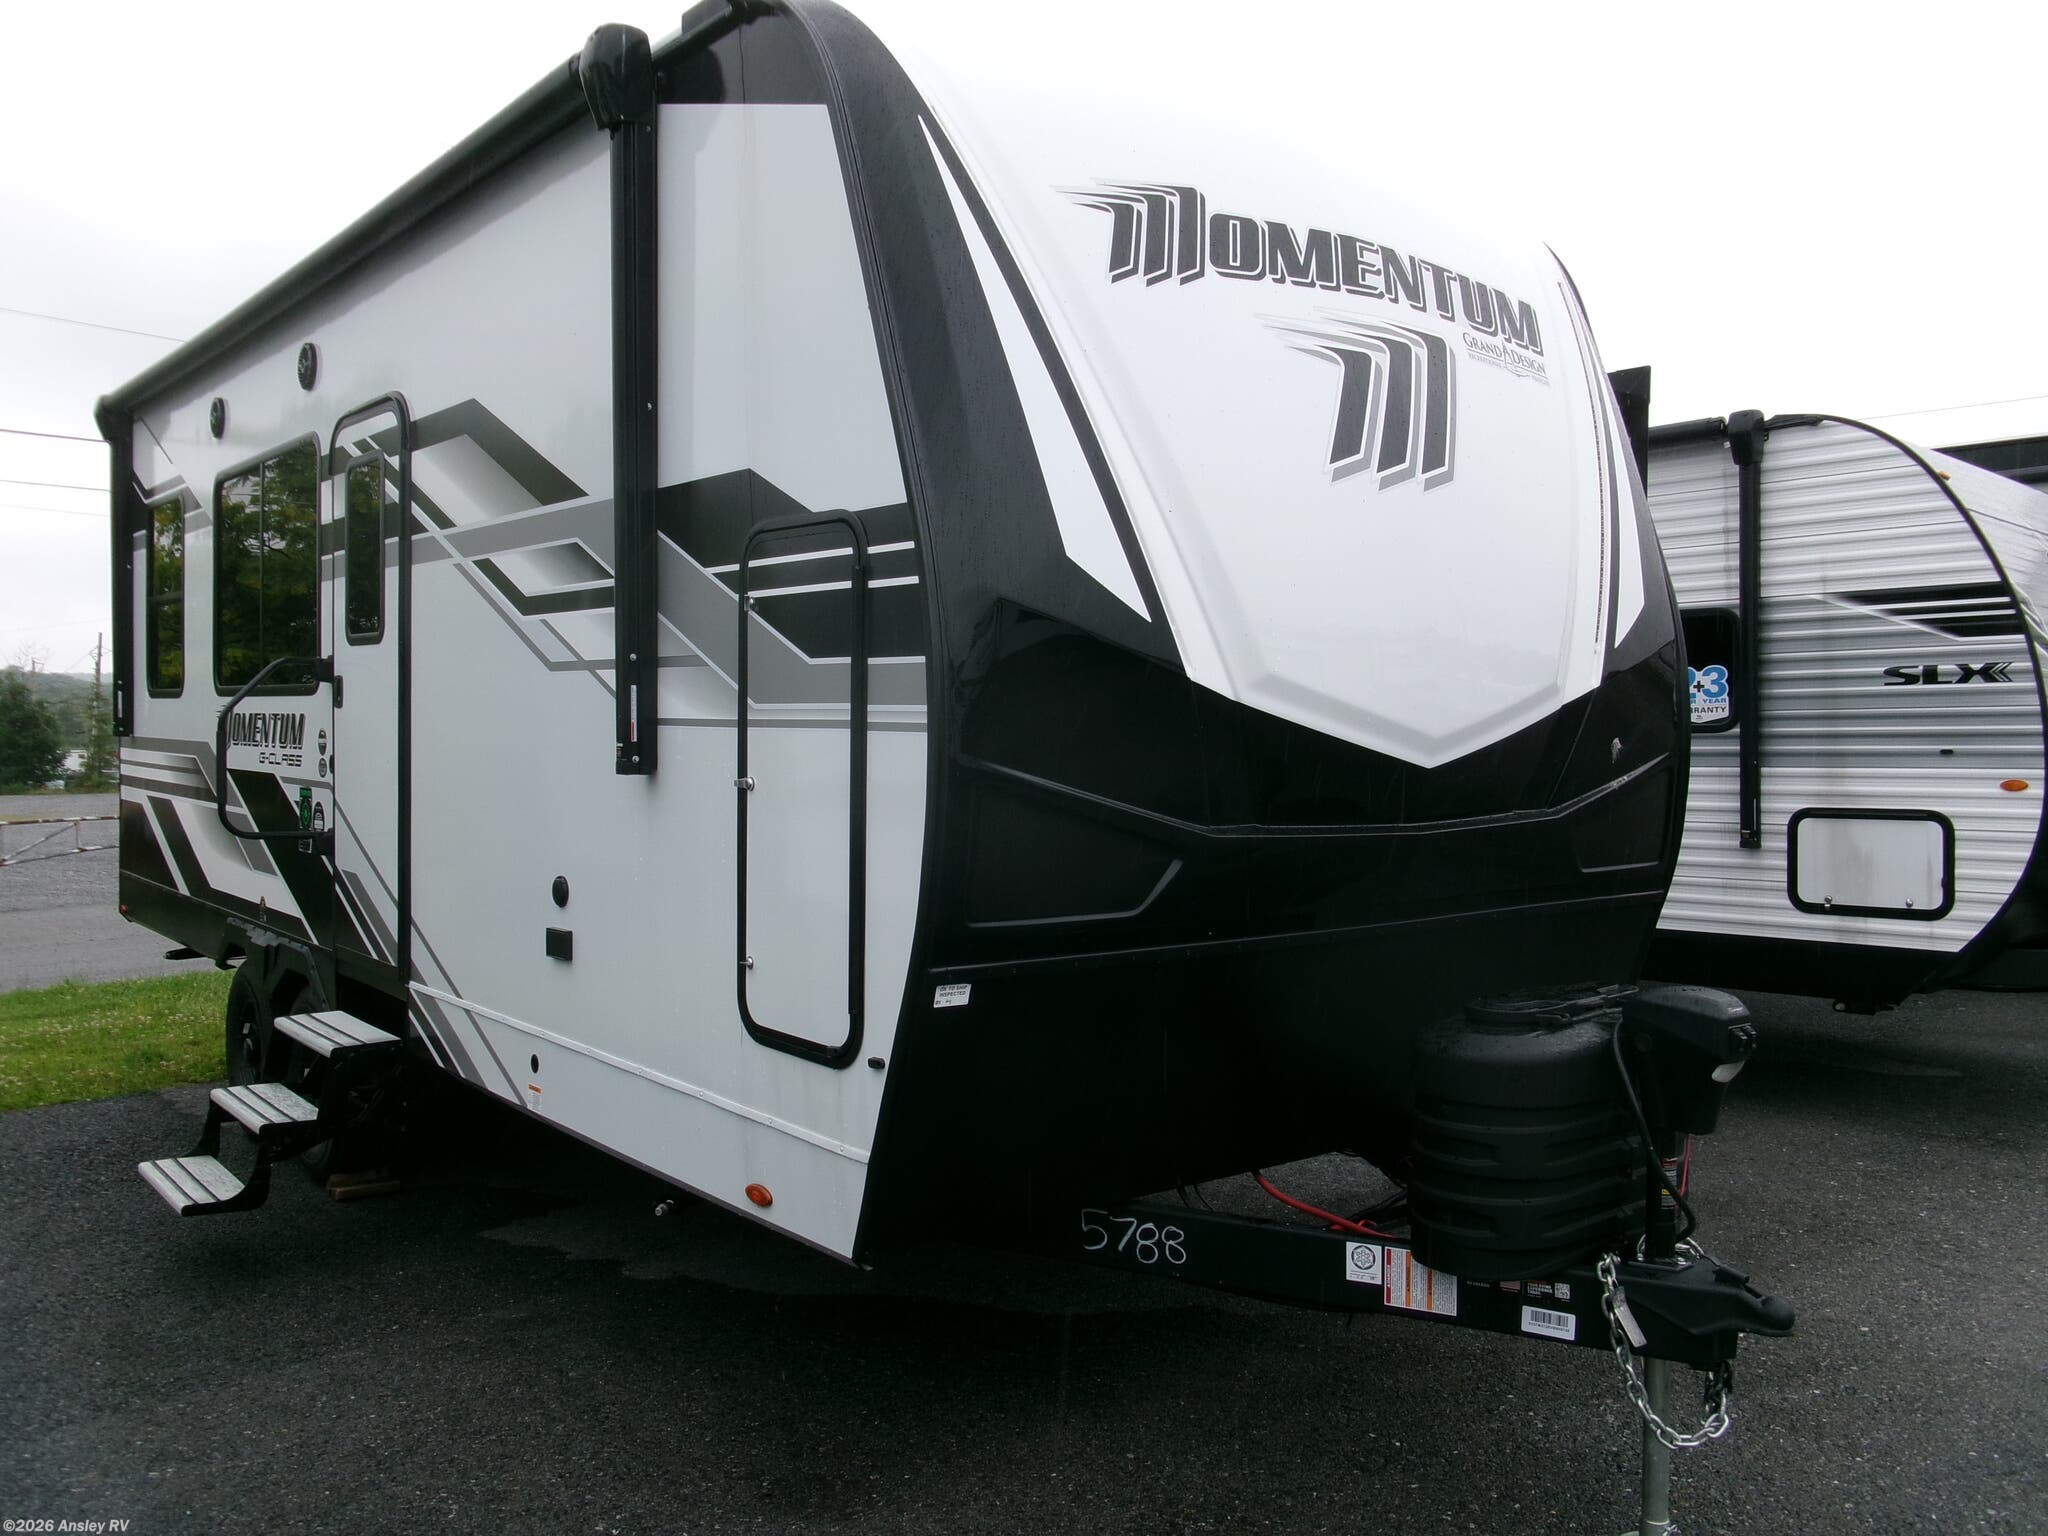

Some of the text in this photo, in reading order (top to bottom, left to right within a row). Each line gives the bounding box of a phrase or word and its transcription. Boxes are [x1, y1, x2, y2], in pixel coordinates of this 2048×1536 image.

[1066, 183, 1545, 358] MOMENTUM
[1463, 332, 1503, 358] GRAND
[1510, 349, 1546, 375] DESIGN
[1883, 661, 2015, 686] SLX
[220, 706, 305, 750] OMENTUM
[259, 752, 302, 767] G-CLASS
[1081, 1208, 1187, 1264] 5788
